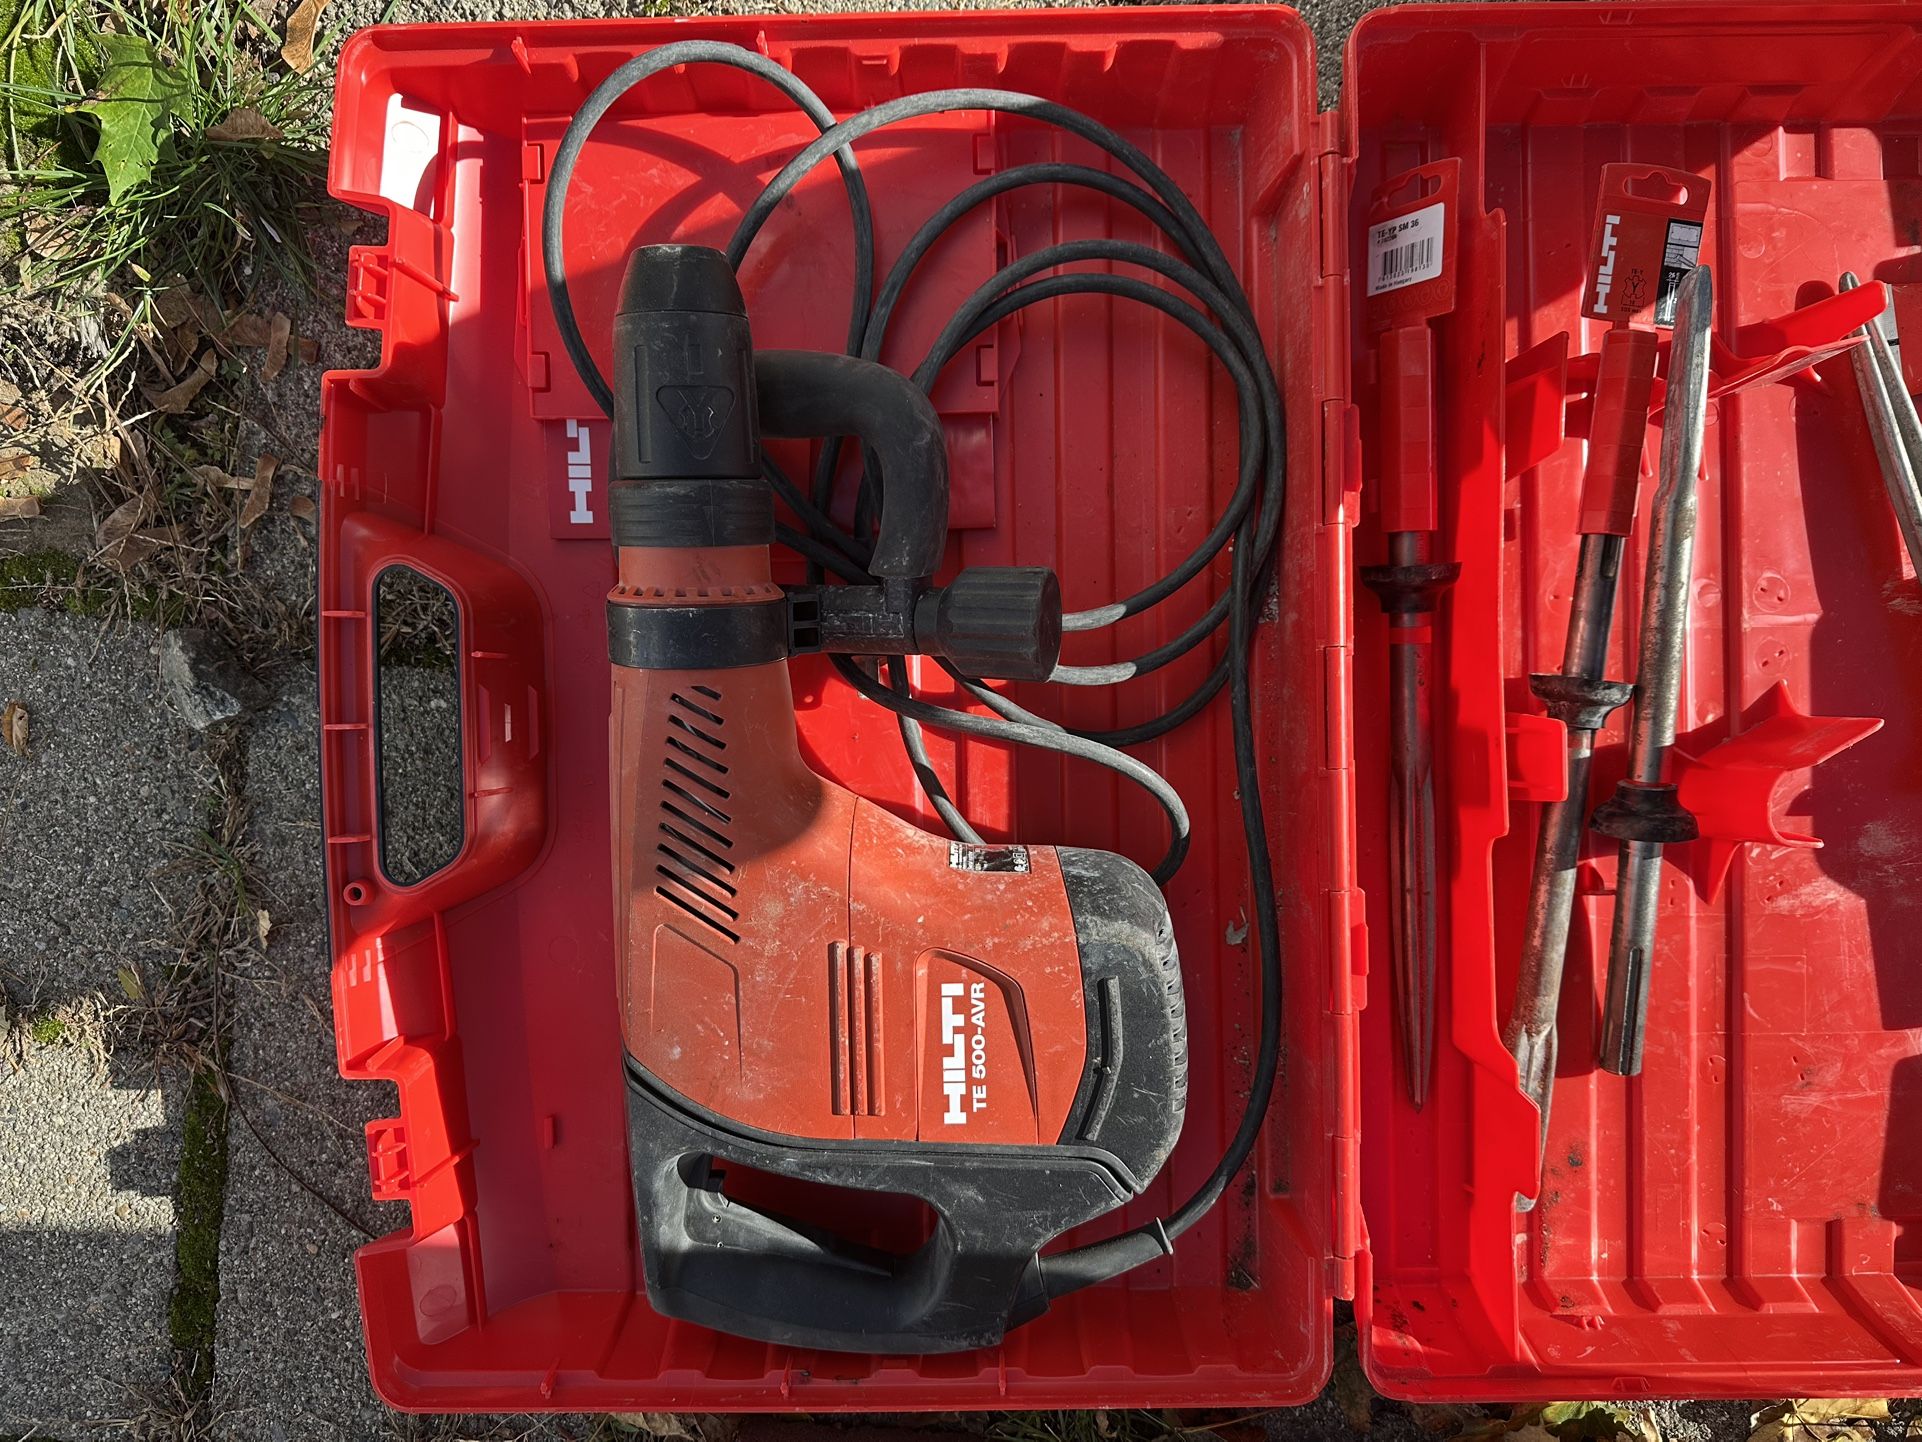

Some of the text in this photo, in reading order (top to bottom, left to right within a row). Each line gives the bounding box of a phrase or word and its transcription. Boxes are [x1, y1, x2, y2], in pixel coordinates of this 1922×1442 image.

[1377, 219, 1420, 238] TE-YP SM 36
[1593, 215, 1621, 314] HILTI
[566, 419, 594, 524] HIL
[941, 983, 966, 1124] HILTI
[970, 982, 987, 1113] TE 500-AVR
